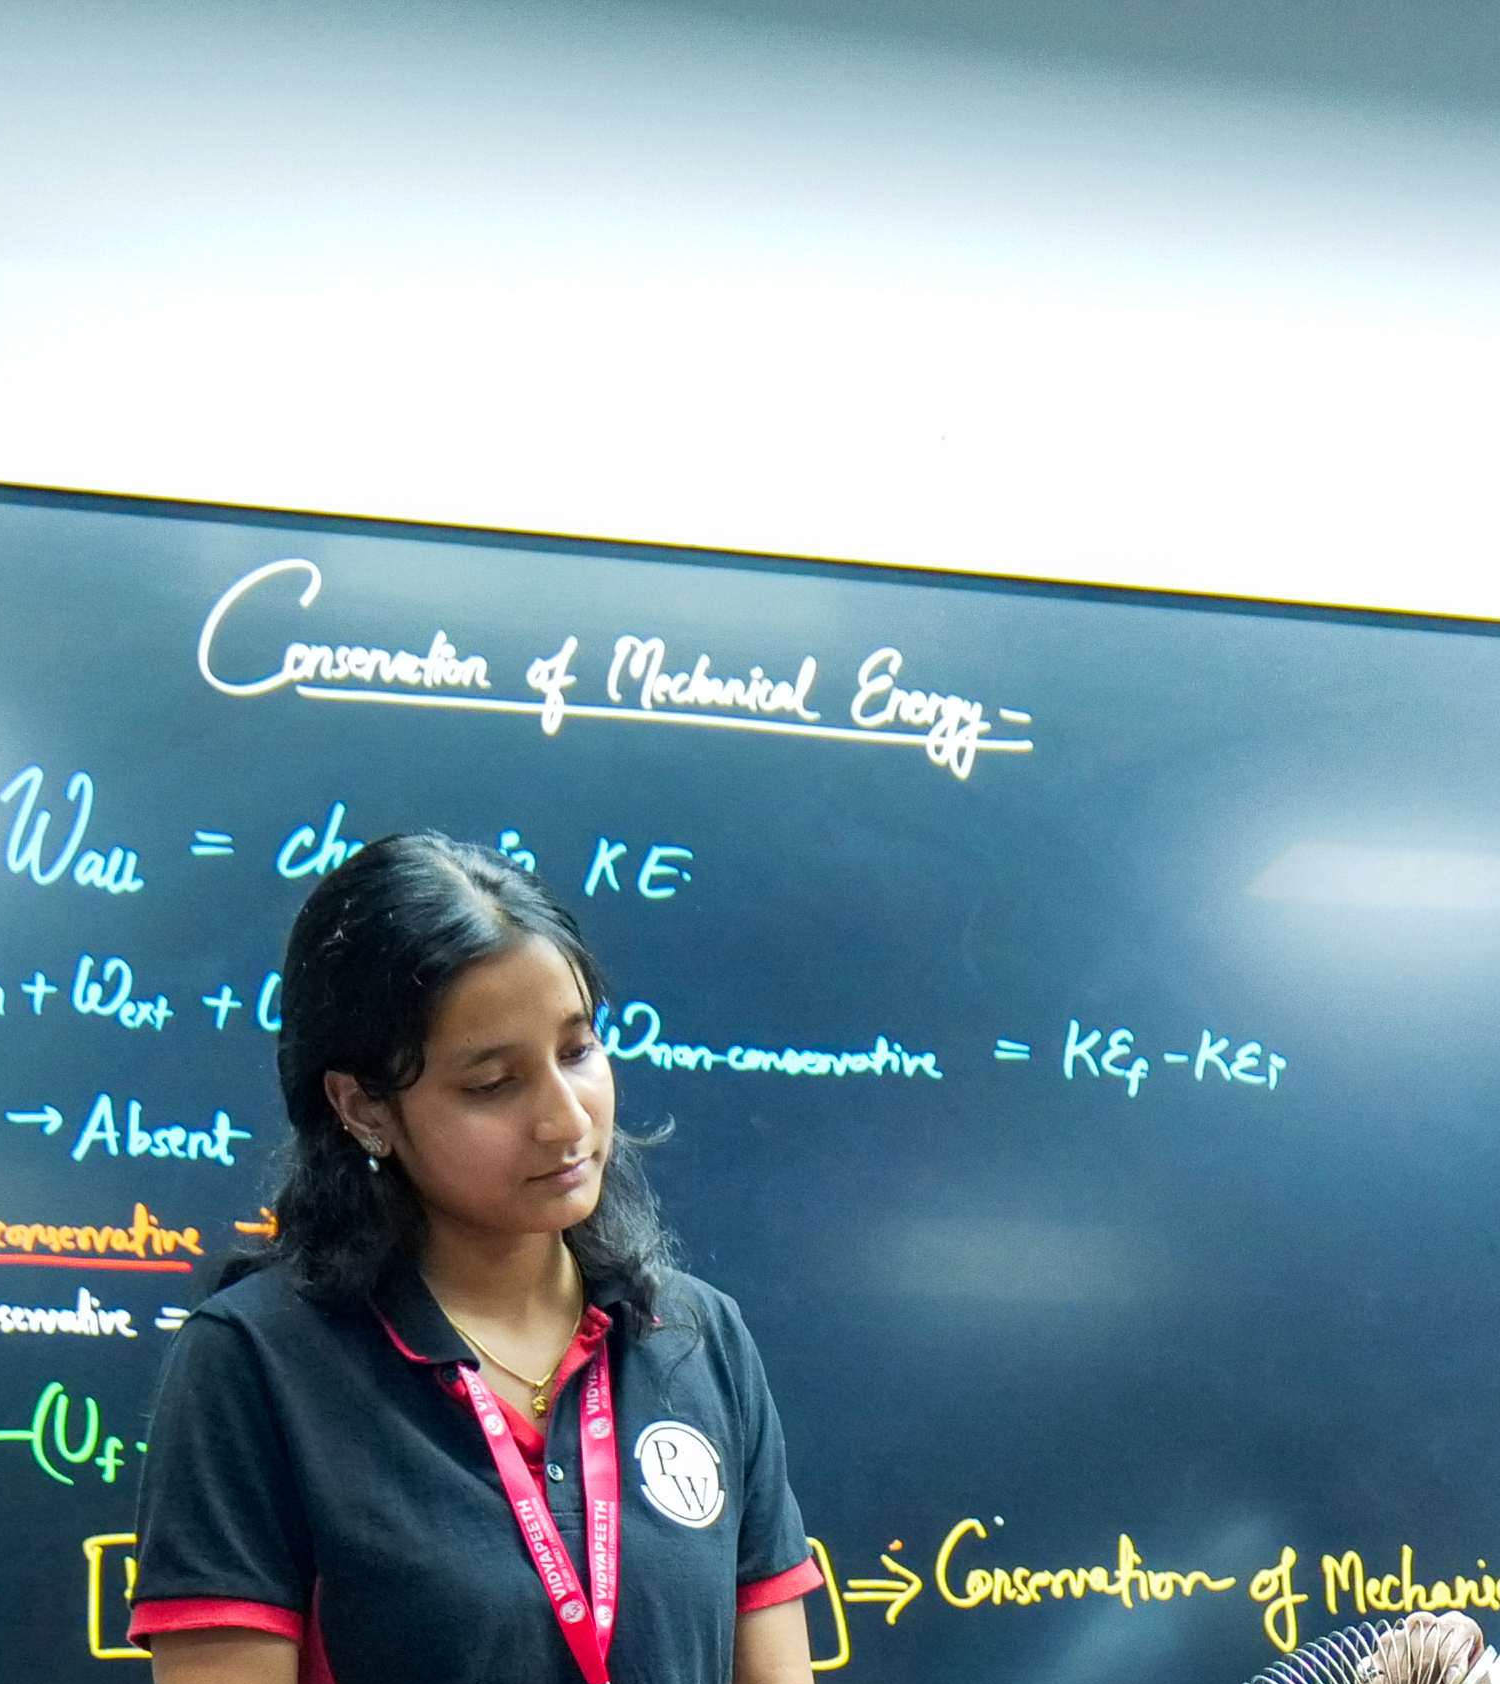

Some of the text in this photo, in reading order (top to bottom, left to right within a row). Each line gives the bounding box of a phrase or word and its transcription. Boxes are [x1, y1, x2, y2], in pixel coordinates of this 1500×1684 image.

[198, 557, 990, 780] Conservation of Mechanical Energy
[71, 1094, 253, 1168] Absent
[652, 1439, 709, 1515] PW
[516, 1499, 567, 1602] VIDYAPEETH
[594, 1499, 608, 1600] VIDYAPEETH
[934, 1517, 1237, 1611] Conservation
[1250, 1544, 1309, 1654] of
